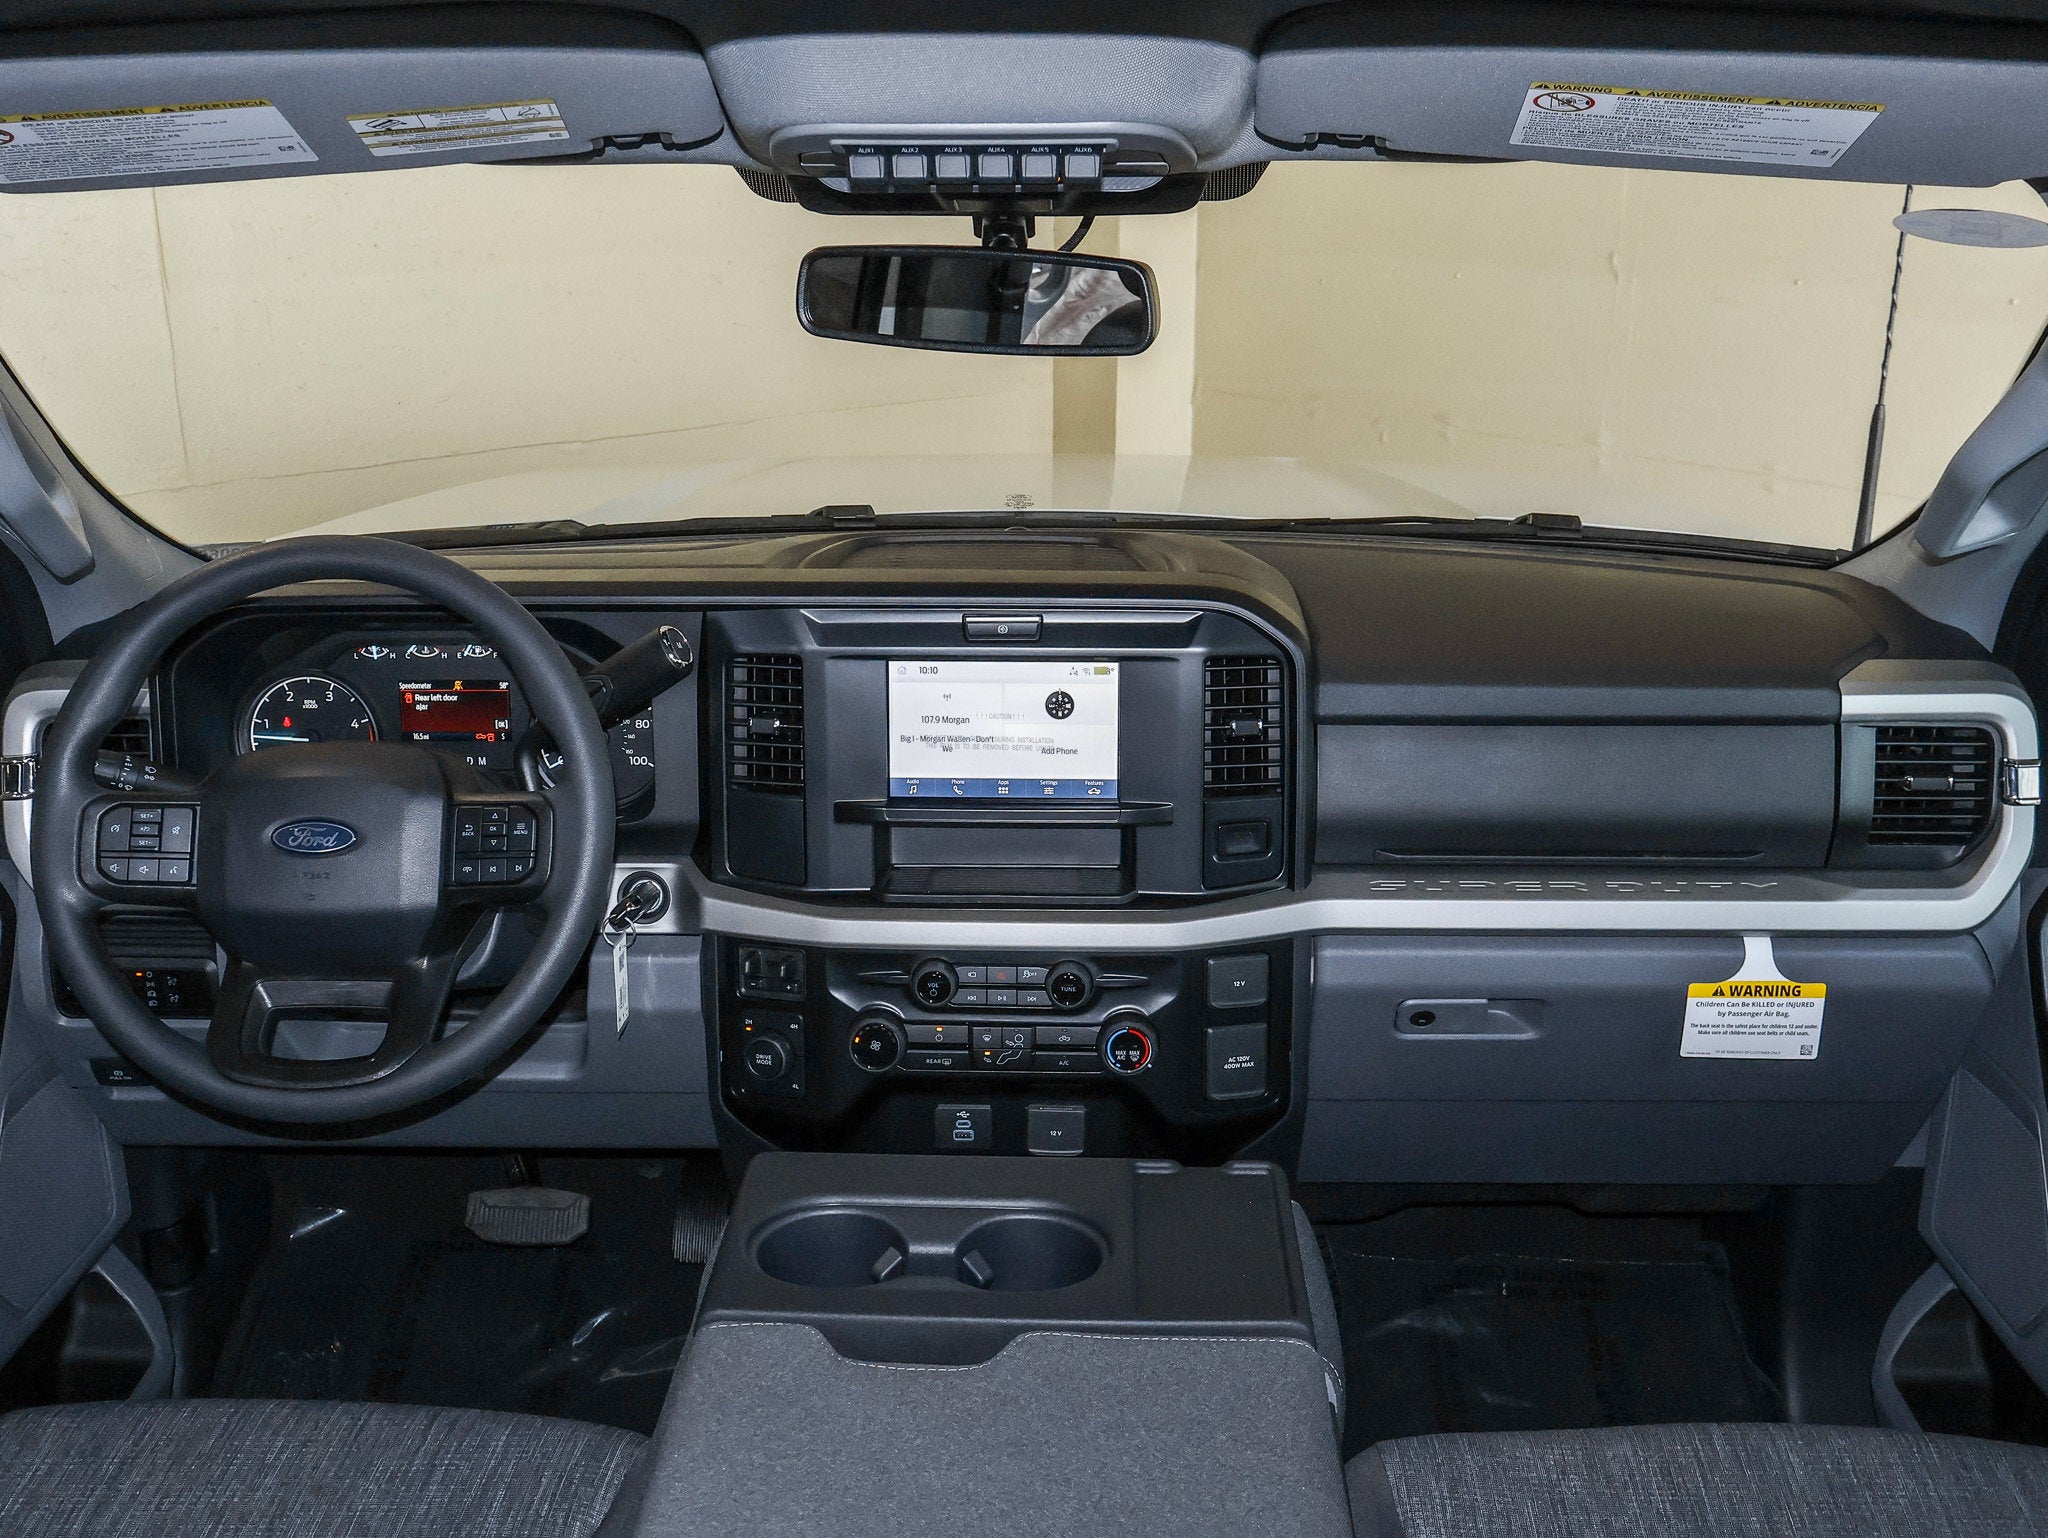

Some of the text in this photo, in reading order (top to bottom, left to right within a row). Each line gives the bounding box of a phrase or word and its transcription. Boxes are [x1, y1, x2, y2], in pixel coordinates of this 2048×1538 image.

[1552, 83, 1614, 94] WARNING
[1646, 91, 1753, 105] AVERTISSEMENT
[1785, 100, 1880, 111] ADVERTENCIA
[178, 99, 267, 111] ADVERTENCIA
[1663, 99, 1706, 107] SERIOUS
[1707, 102, 1743, 110] INJURY
[919, 666, 938, 674] 10:10
[399, 682, 432, 690] Speedometer
[286, 691, 294, 702] 2
[326, 691, 333, 702] 3
[415, 693, 458, 702] Rear left door
[263, 719, 269, 729] 1
[350, 719, 359, 729] 4
[635, 719, 650, 729] 80
[921, 716, 970, 725] 107.9 Morgan
[900, 735, 912, 743] Big
[920, 735, 946, 744] Morgan
[1041, 747, 1055, 755] Add
[1056, 747, 1078, 755] Phone
[479, 756, 486, 765] M
[629, 756, 648, 765] 100
[288, 826, 339, 847] Ford
[1729, 985, 1801, 997] WARNING
[1785, 1001, 1814, 1009] INJURED
[1718, 1010, 1726, 1018] by
[1727, 1010, 1762, 1018] Passenger
